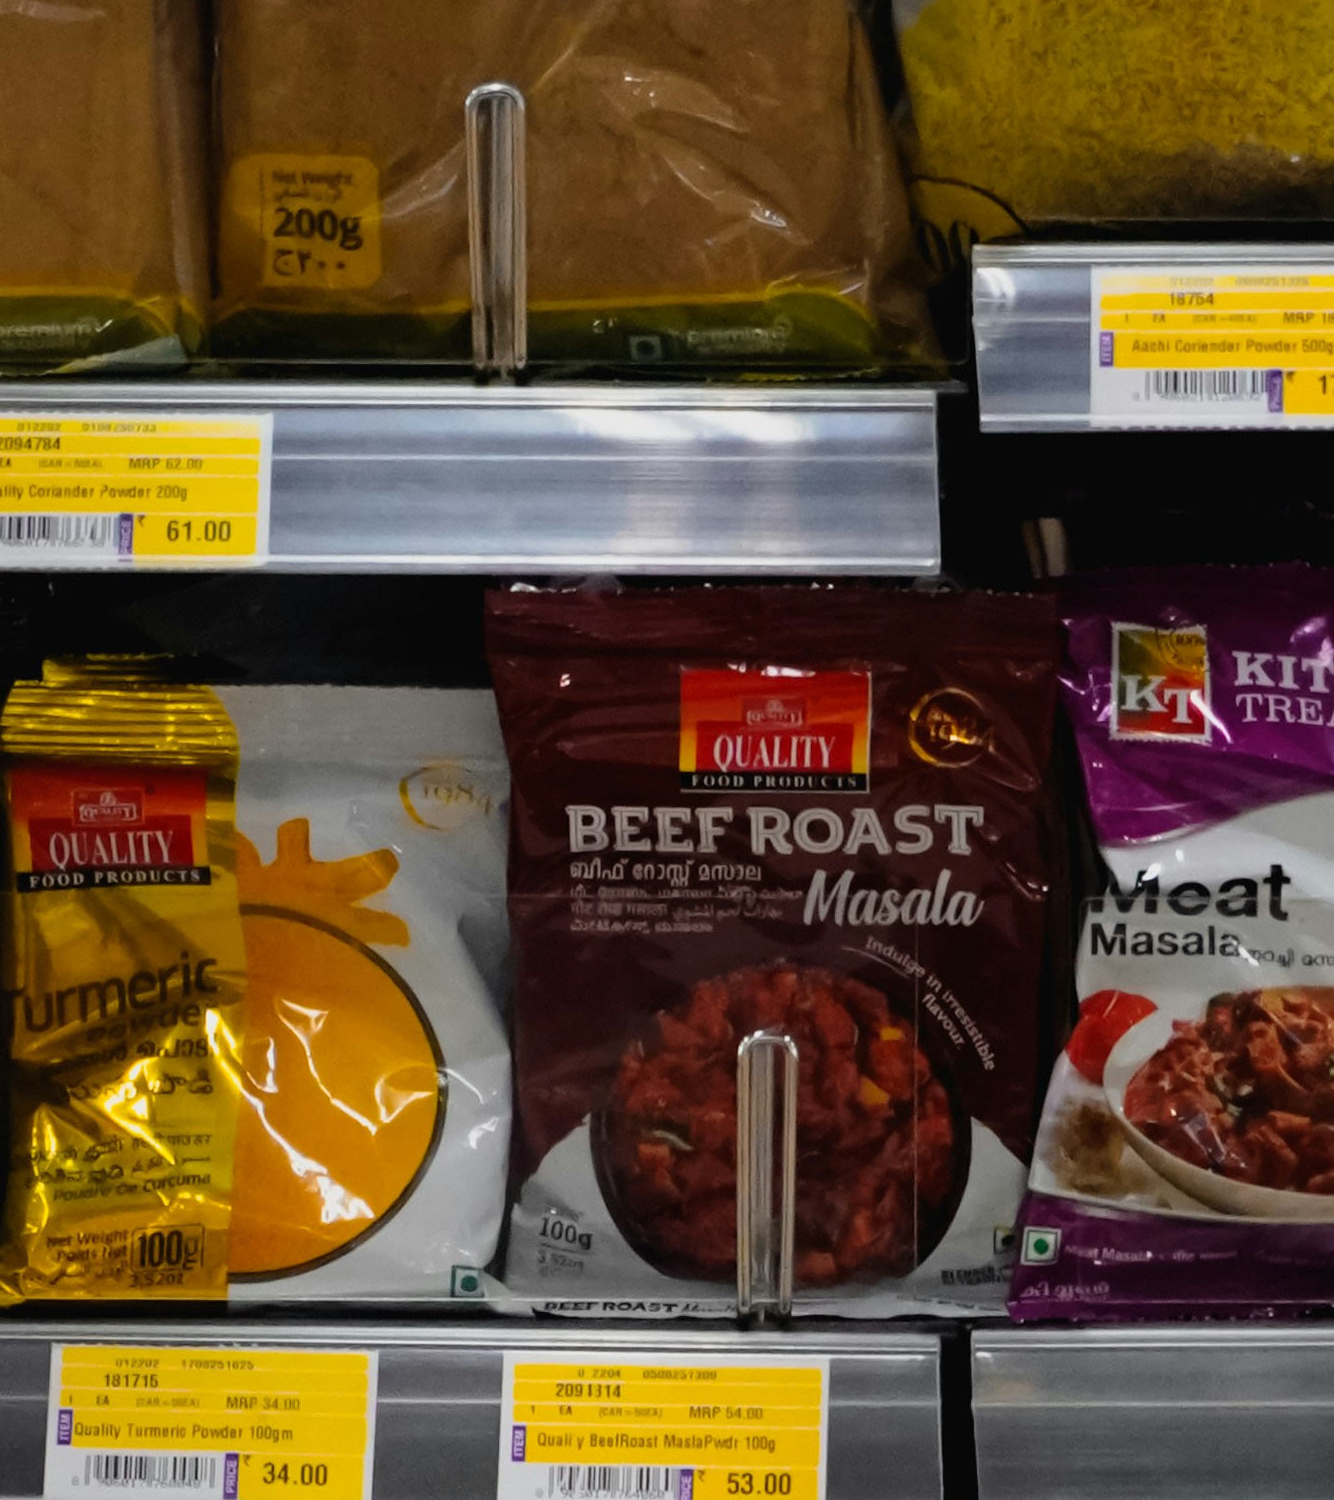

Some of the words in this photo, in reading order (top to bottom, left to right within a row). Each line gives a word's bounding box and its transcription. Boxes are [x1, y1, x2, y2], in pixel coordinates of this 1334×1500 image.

[274, 205, 363, 250] 200g
[29, 485, 94, 498] Coriander
[100, 485, 151, 498] Powder
[156, 485, 187, 502] 200g
[166, 521, 231, 542] 61.00
[713, 735, 837, 769] QUALITY
[691, 774, 745, 788] FOOD
[753, 774, 859, 790] PRODUCTS
[567, 806, 732, 853] BEEF
[746, 805, 985, 855] ROAST
[48, 830, 172, 870] QUALITY
[804, 869, 984, 928] Masala
[136, 1232, 200, 1273] 100g
[263, 1462, 328, 1486] 34.00
[727, 1473, 791, 1495] 53.00
